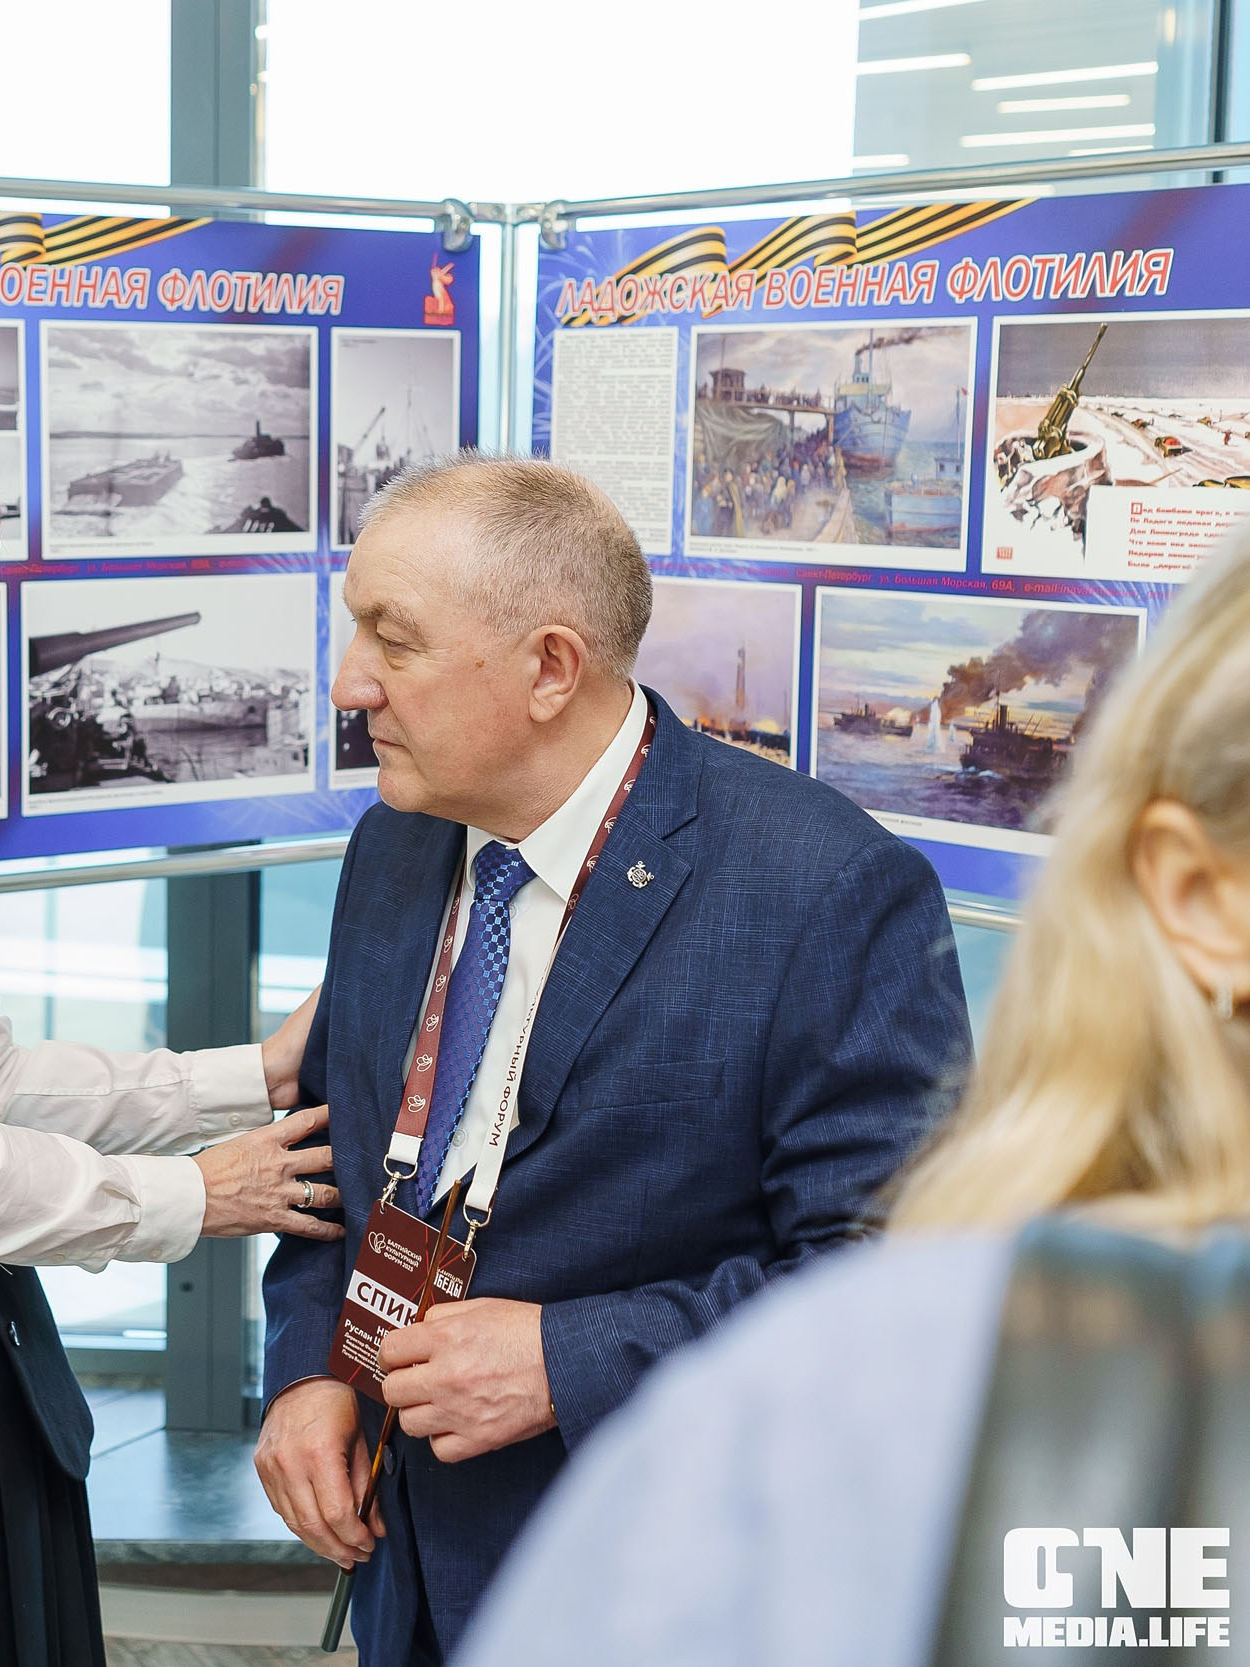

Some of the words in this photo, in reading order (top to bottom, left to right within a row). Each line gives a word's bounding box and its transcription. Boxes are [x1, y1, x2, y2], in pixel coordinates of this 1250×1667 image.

[156, 264, 345, 316] ФЛОТИЛИЯ
[555, 267, 757, 324] ЛАДОЖСКАЯ
[762, 258, 940, 310] ВОЕННАЯ
[947, 245, 1175, 305] ФЛОТИЛИЯ
[893, 573, 938, 586] Большая
[489, 1085, 512, 1147] ФОРУМ
[383, 1251, 403, 1266] ФОРУМ
[401, 1260, 414, 1272] 2025
[385, 1245, 419, 1268] КУЛЬТУРНЫЙ
[387, 1238, 422, 1262] БАЛТИЙСКИЙ
[357, 1281, 417, 1326] СПИК
[344, 1318, 373, 1342] Руслан
